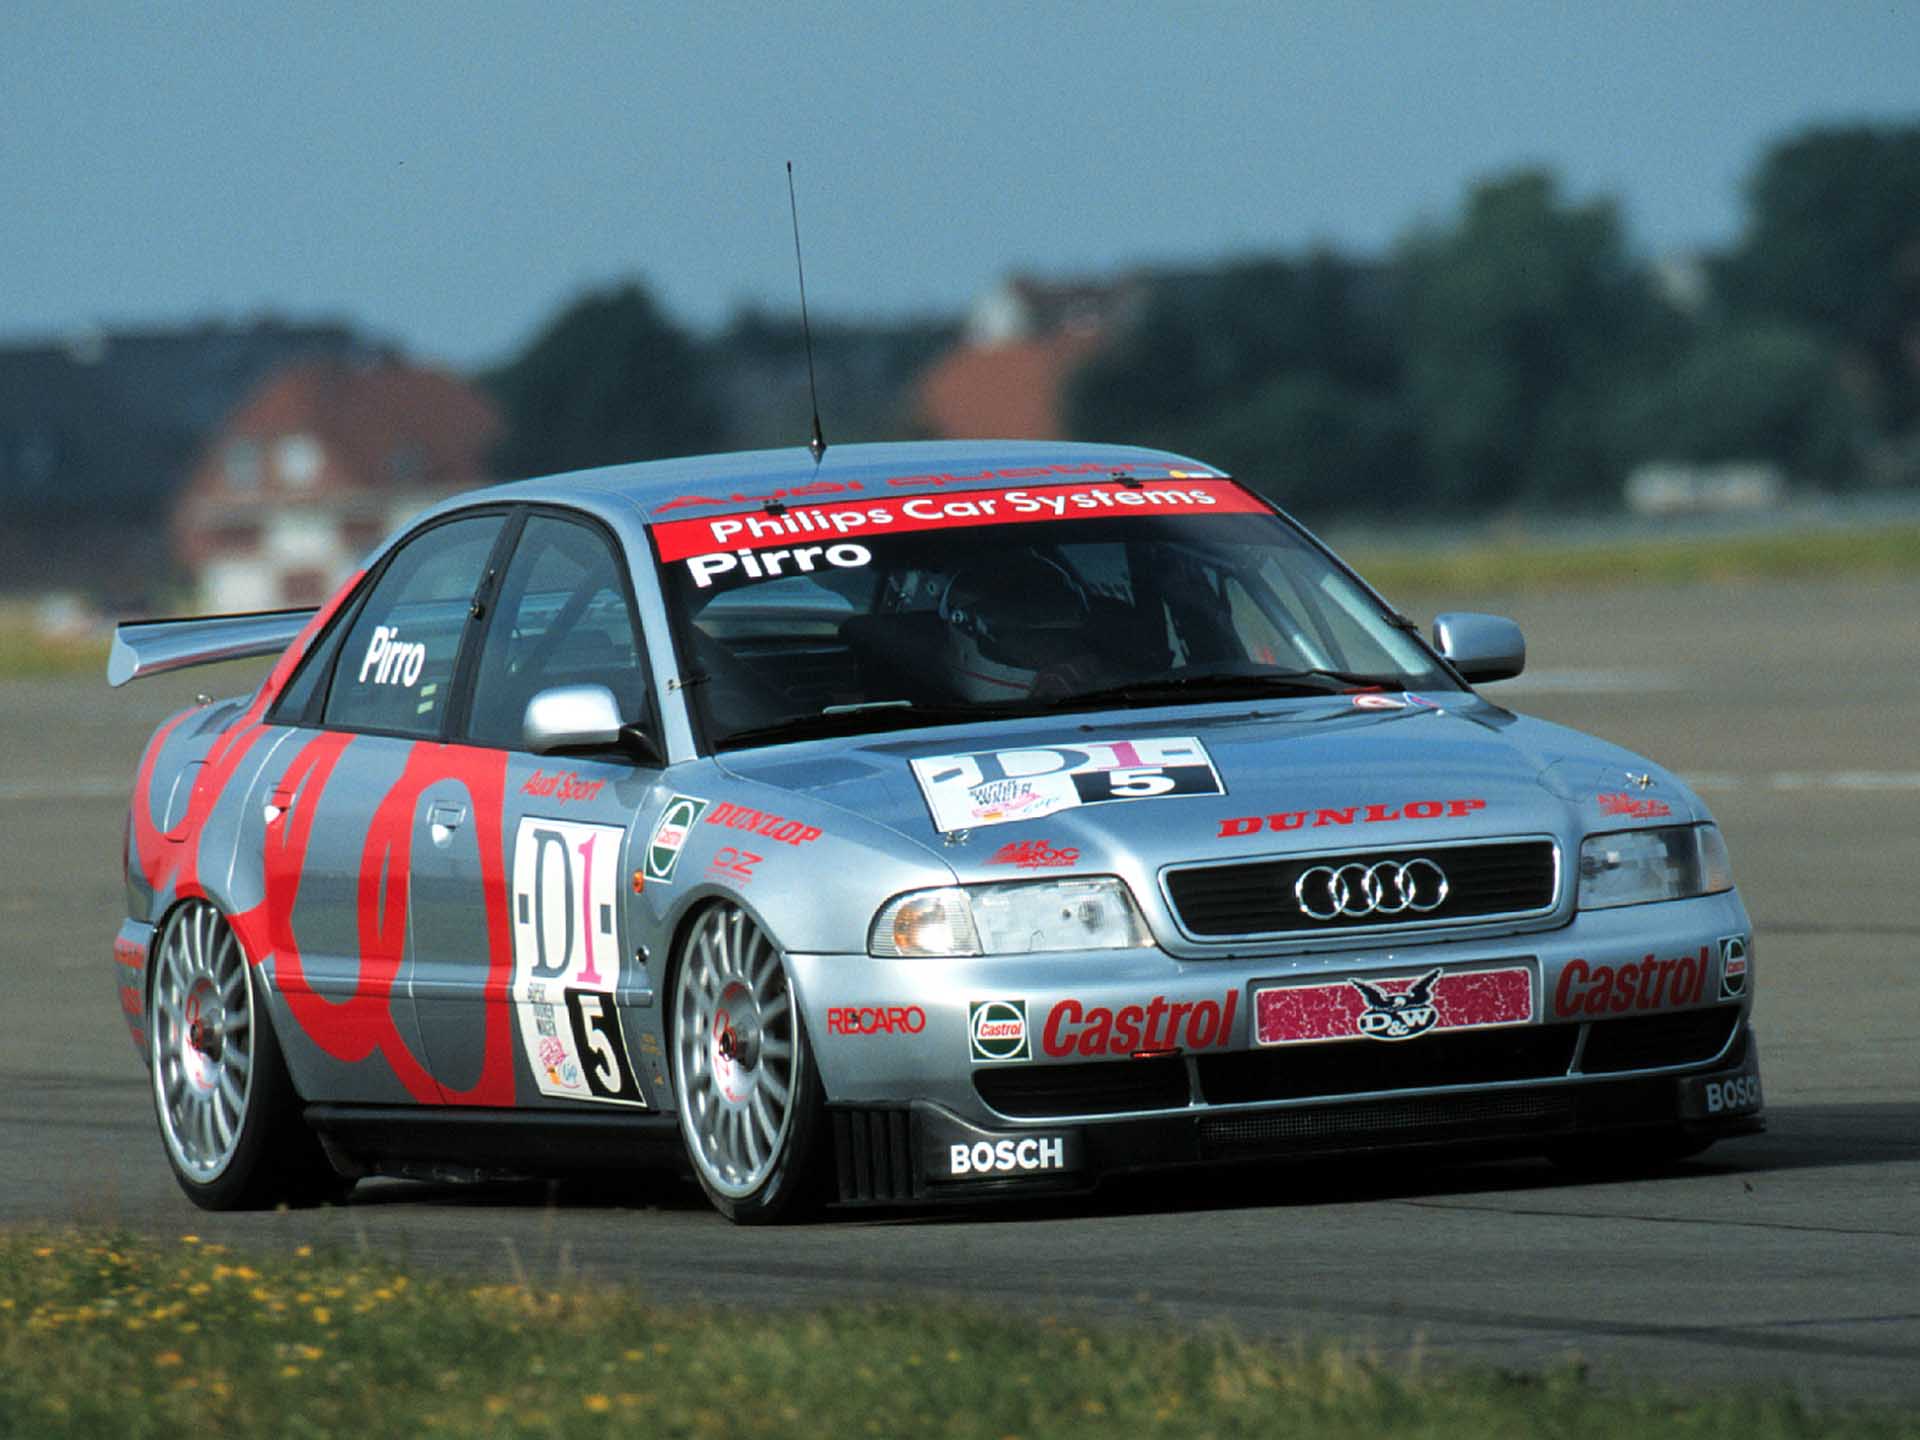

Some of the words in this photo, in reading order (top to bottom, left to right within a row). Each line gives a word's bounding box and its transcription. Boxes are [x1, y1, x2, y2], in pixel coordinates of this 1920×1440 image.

[709, 507, 894, 543] Philips
[902, 497, 996, 520] Car
[1004, 489, 1217, 515] Systems
[686, 543, 872, 588] Pirro
[359, 626, 425, 687] Pirro
[1109, 768, 1176, 796] 5
[704, 801, 823, 847] DUNLOP
[1217, 799, 1487, 838] DUNLOP
[713, 847, 764, 875] OZ
[531, 828, 602, 985] D1
[1555, 946, 1709, 1017] Castrol
[827, 1005, 926, 1035] RECARO
[980, 1022, 1022, 1037] Castrol
[1042, 989, 1239, 1058] Castrol
[577, 995, 622, 1093] 5
[950, 1138, 1064, 1174] BOSCH
